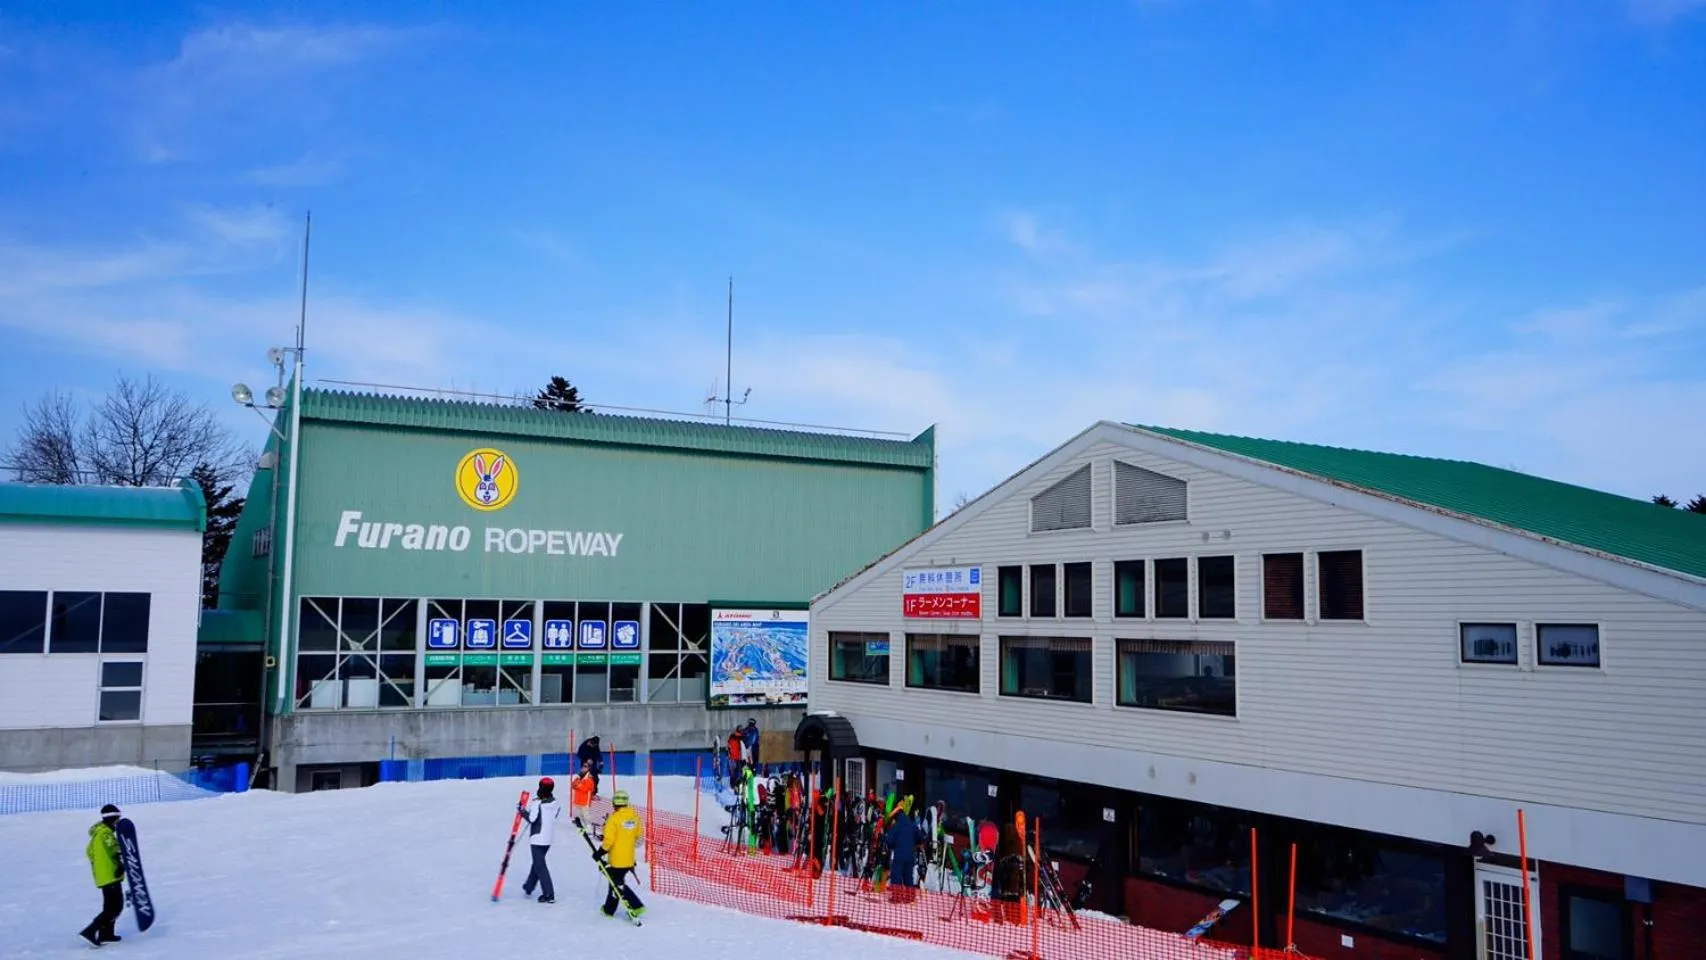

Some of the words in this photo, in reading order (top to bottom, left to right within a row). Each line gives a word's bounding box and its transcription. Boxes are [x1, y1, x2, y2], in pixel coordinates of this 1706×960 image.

[334, 510, 471, 551] Furano
[484, 527, 624, 557] ROPEWAY
[905, 575, 917, 589] 2F
[918, 571, 963, 584] 無料休憩所
[905, 599, 917, 612] 1F
[918, 596, 976, 608] ラーメンコーナー
[120, 833, 152, 917] SALOMON
